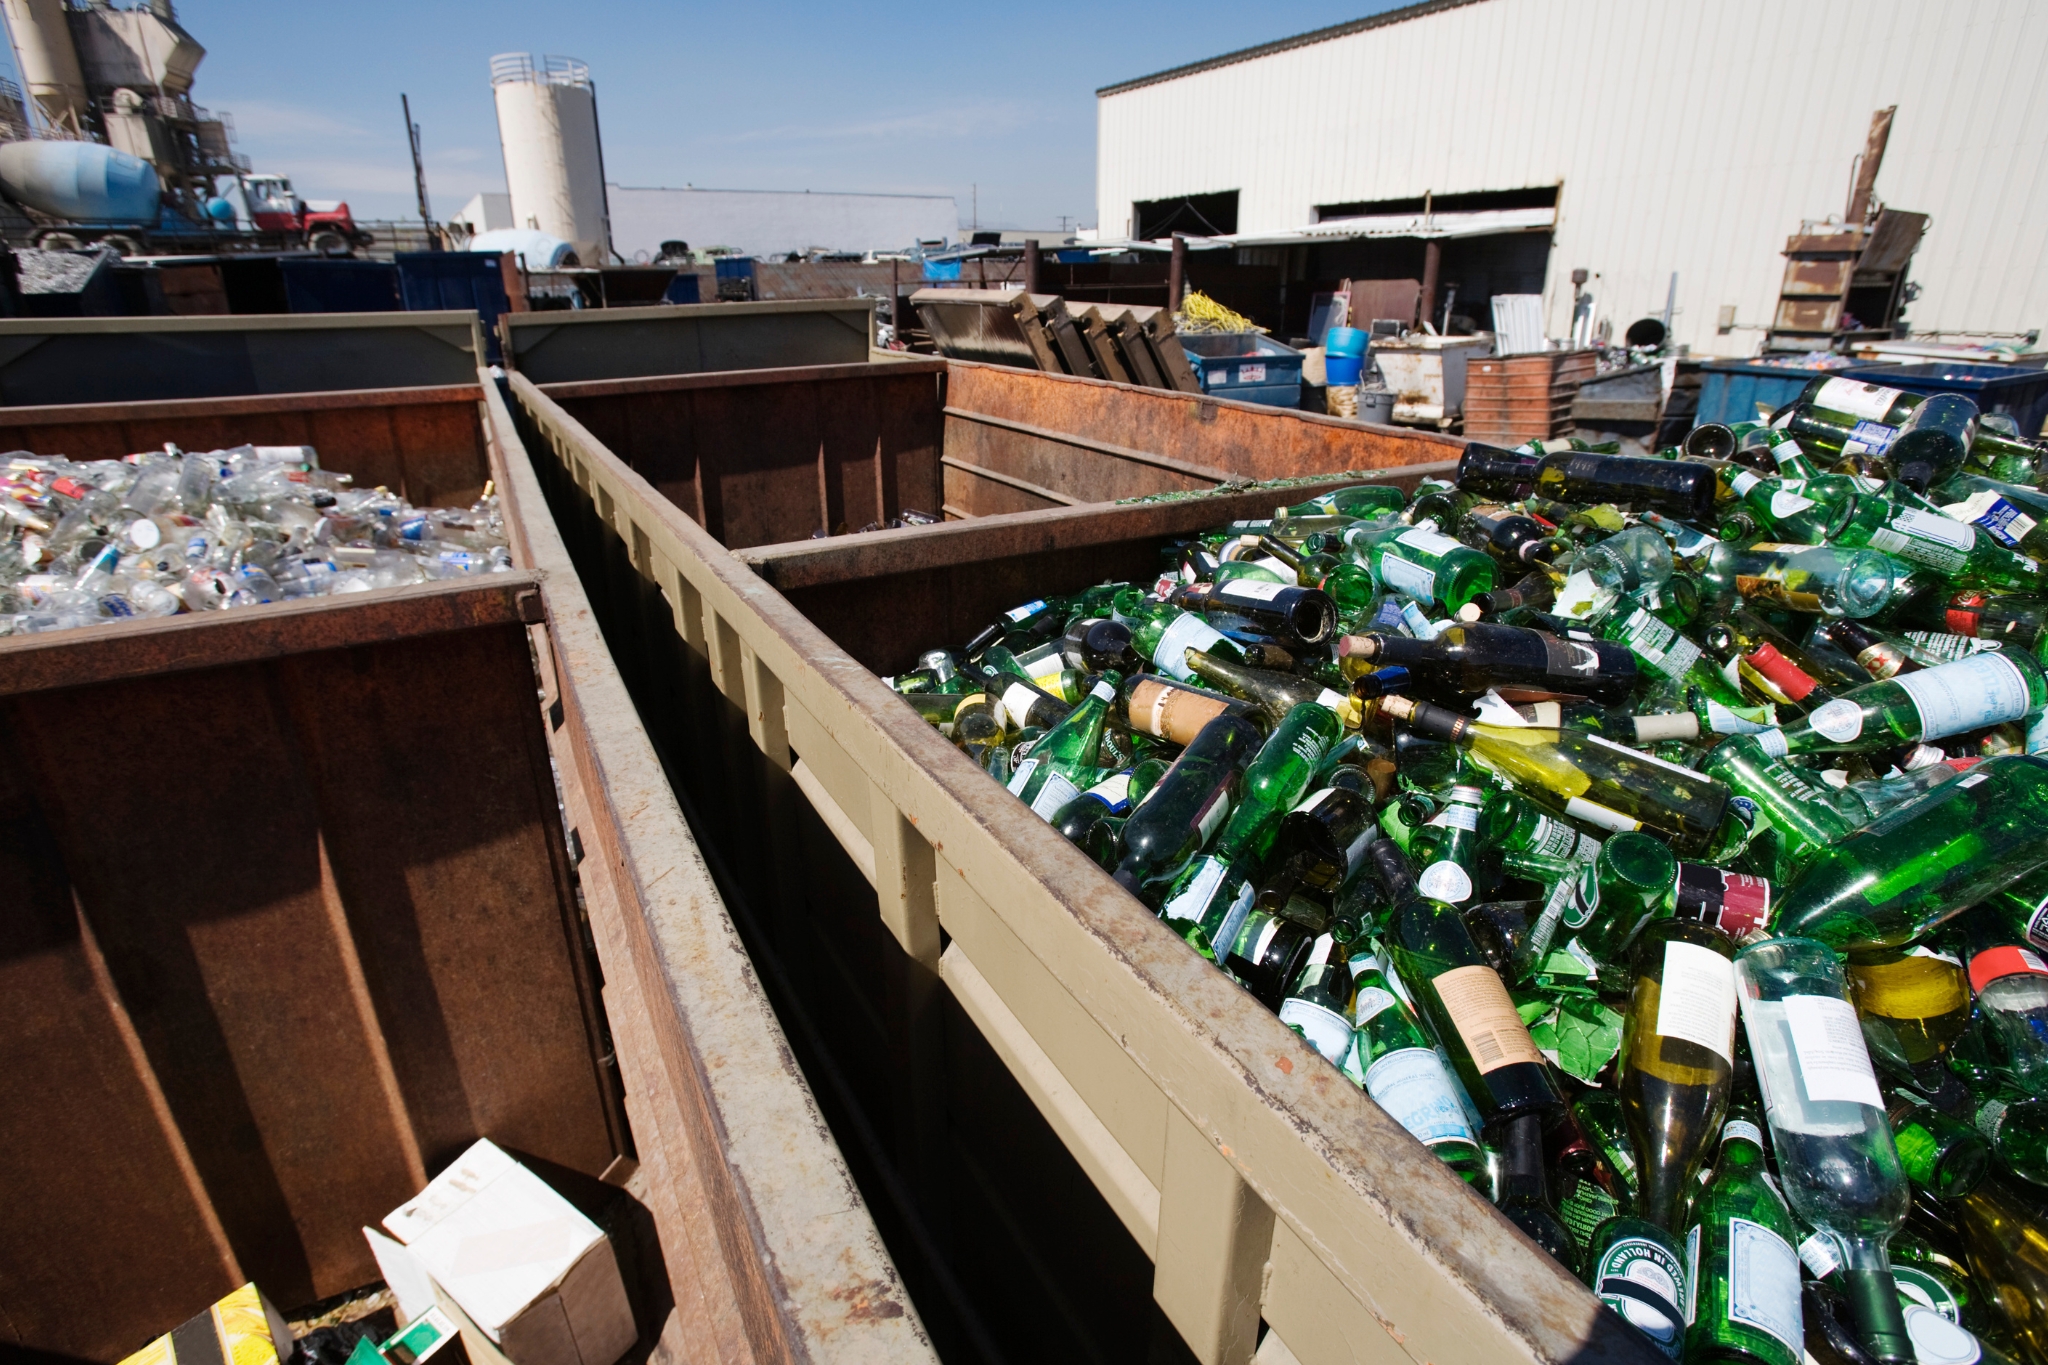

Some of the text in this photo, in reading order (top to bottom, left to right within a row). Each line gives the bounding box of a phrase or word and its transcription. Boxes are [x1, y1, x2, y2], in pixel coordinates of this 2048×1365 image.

[1611, 1246, 1651, 1270] HOLLAND
[1653, 1253, 1665, 1266] IN
[1666, 1264, 1687, 1304] BREWED
